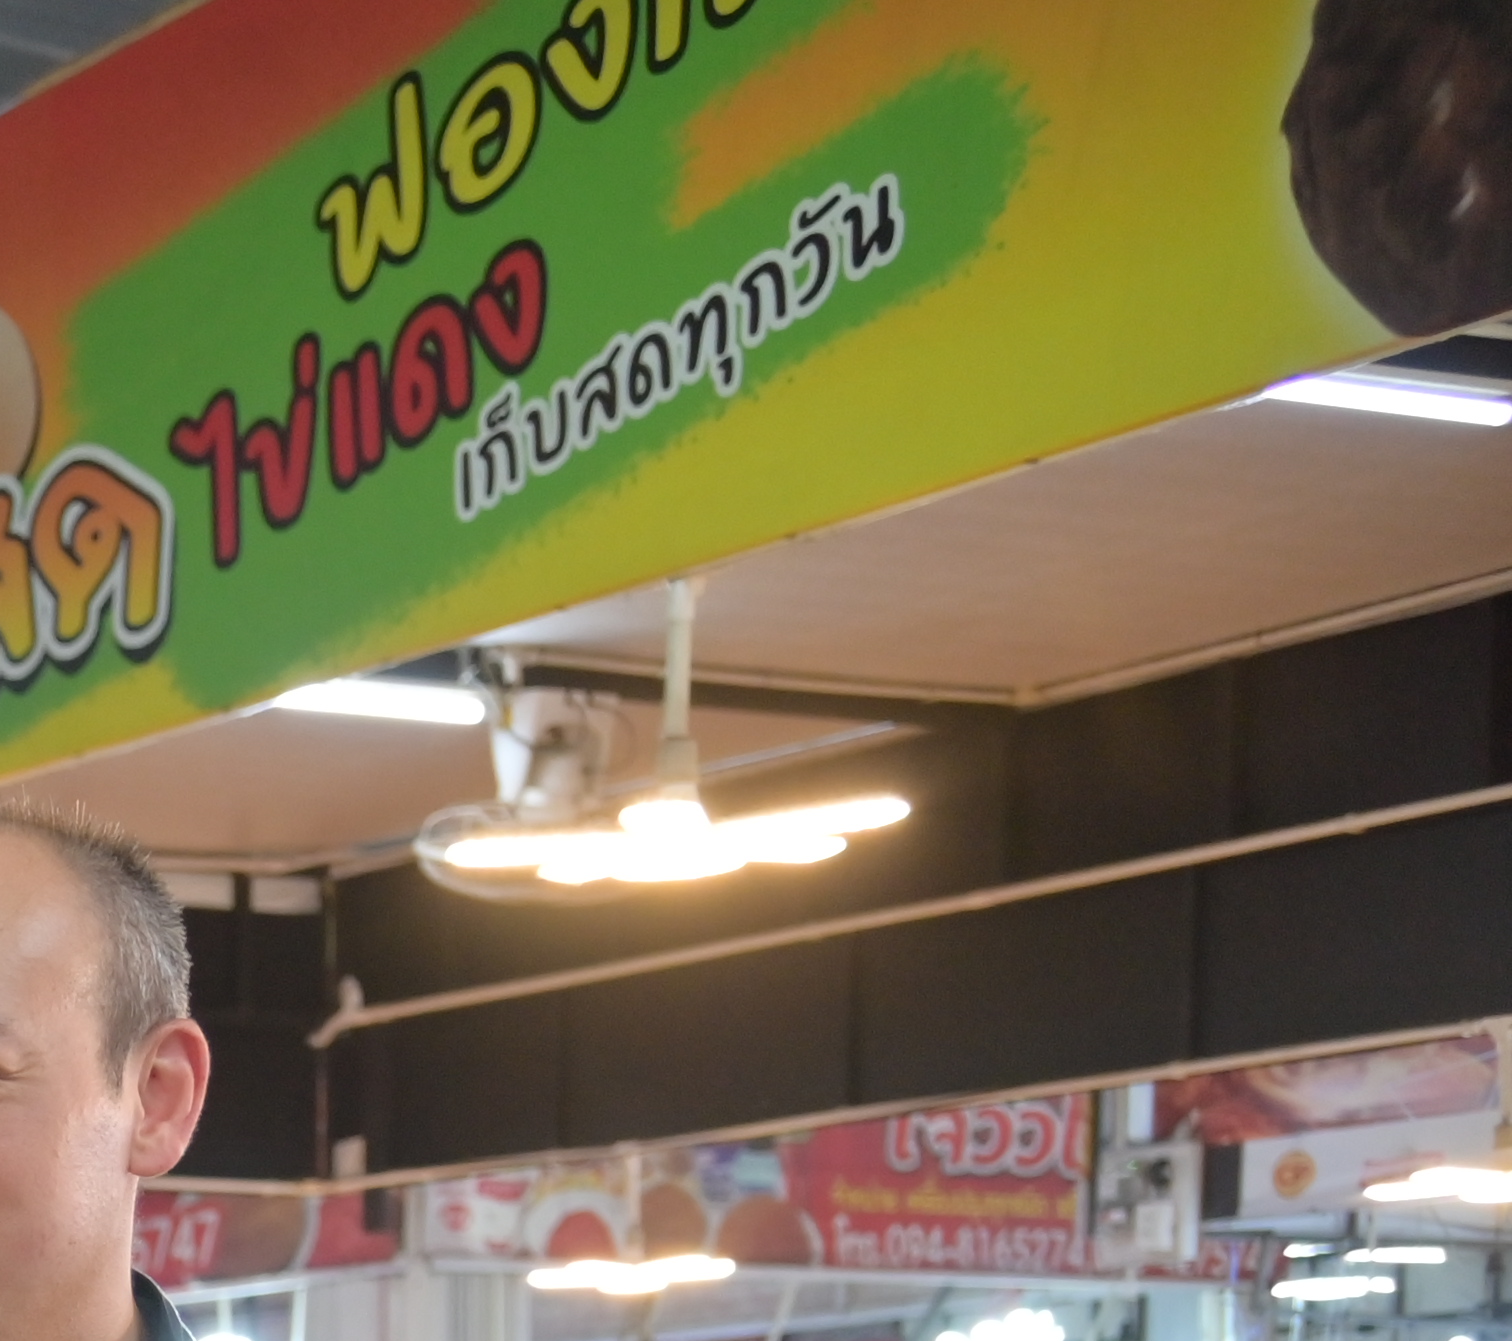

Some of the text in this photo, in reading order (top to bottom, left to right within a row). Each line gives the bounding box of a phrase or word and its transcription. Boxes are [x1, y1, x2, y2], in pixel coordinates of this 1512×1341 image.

[171, 240, 547, 566] ไข่แดง
[457, 178, 900, 517] เก็บสดทุกวัน
